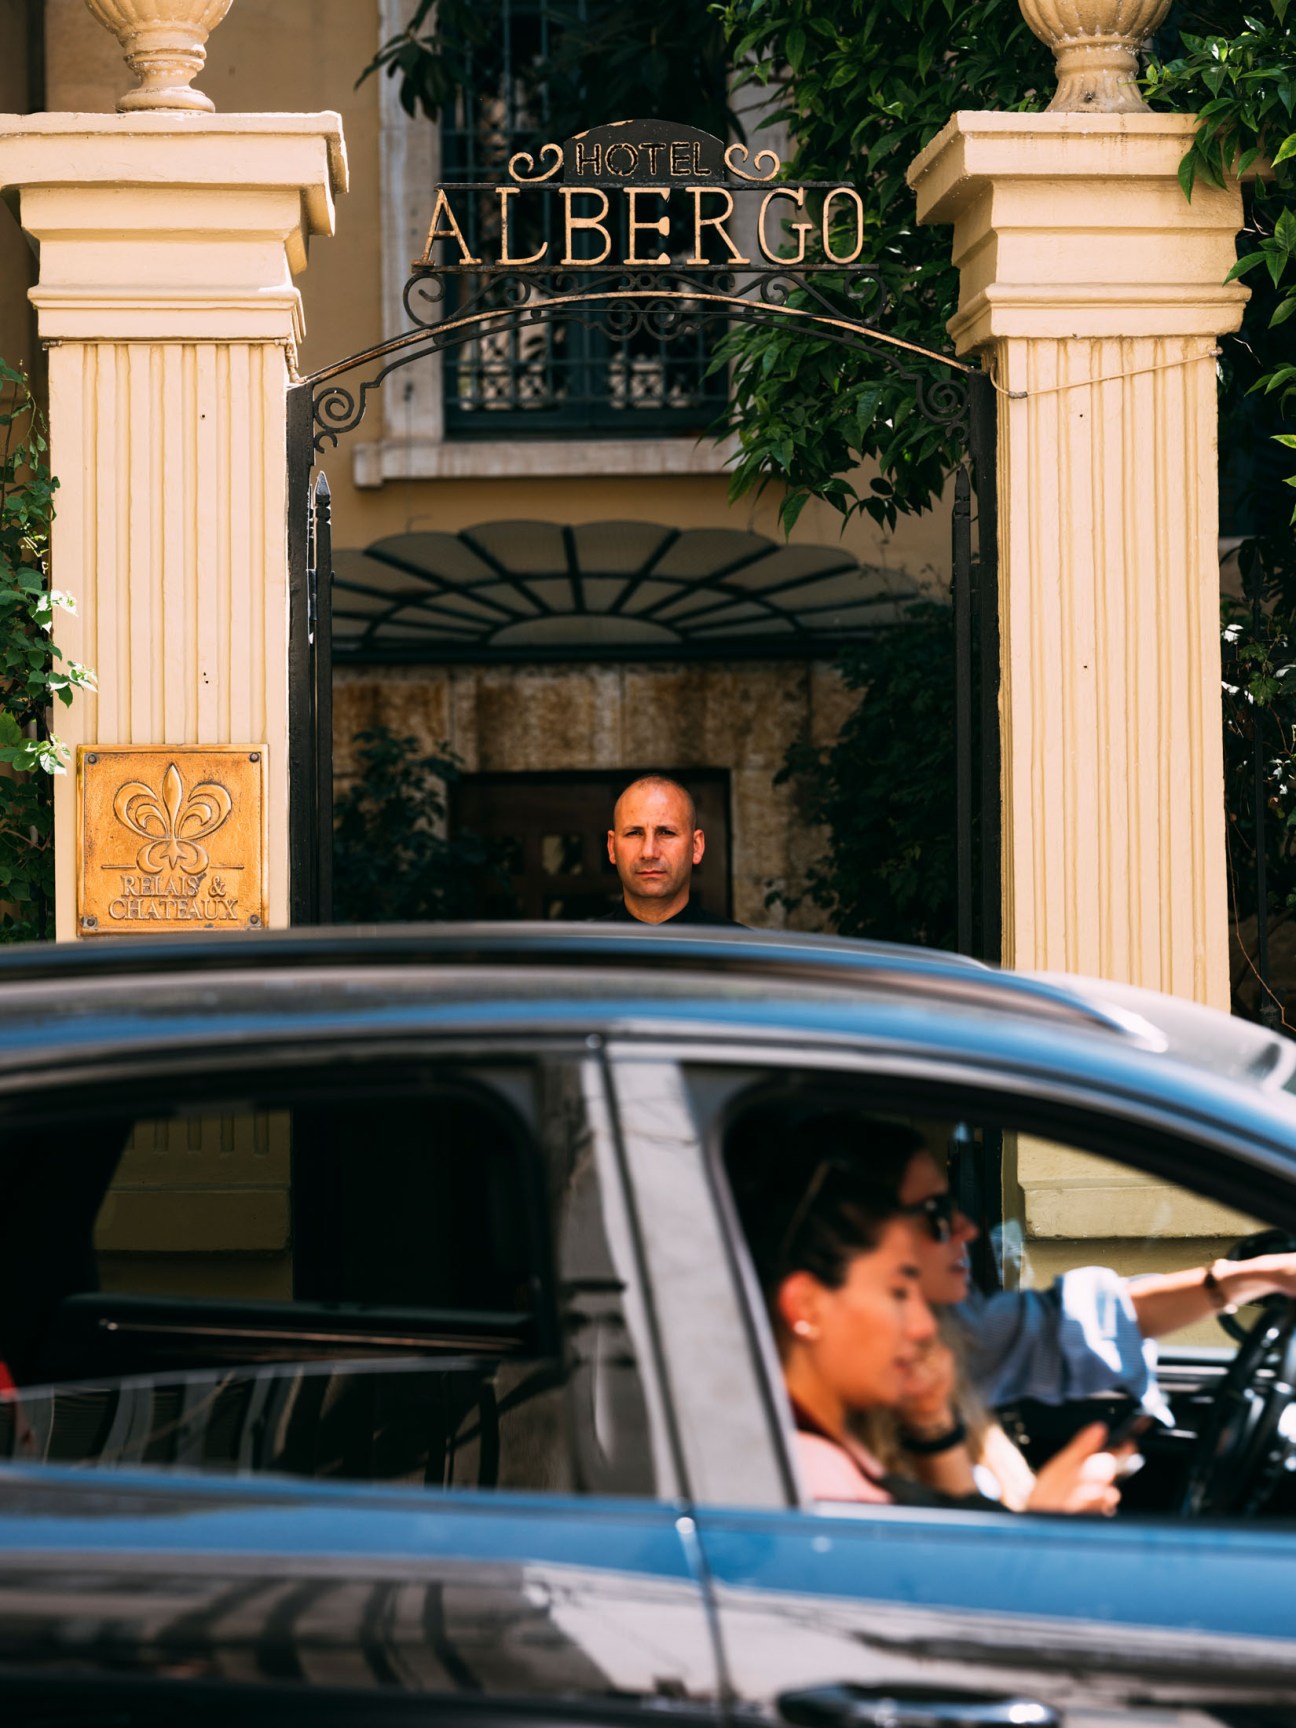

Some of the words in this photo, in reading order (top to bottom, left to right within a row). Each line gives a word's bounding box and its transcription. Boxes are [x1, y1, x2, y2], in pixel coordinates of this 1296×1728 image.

[576, 142, 711, 176] HOTEL
[411, 187, 864, 266] ALBERGO
[121, 875, 199, 897] RELAIS
[208, 875, 226, 897] &
[109, 898, 238, 920] CHATEAUX
